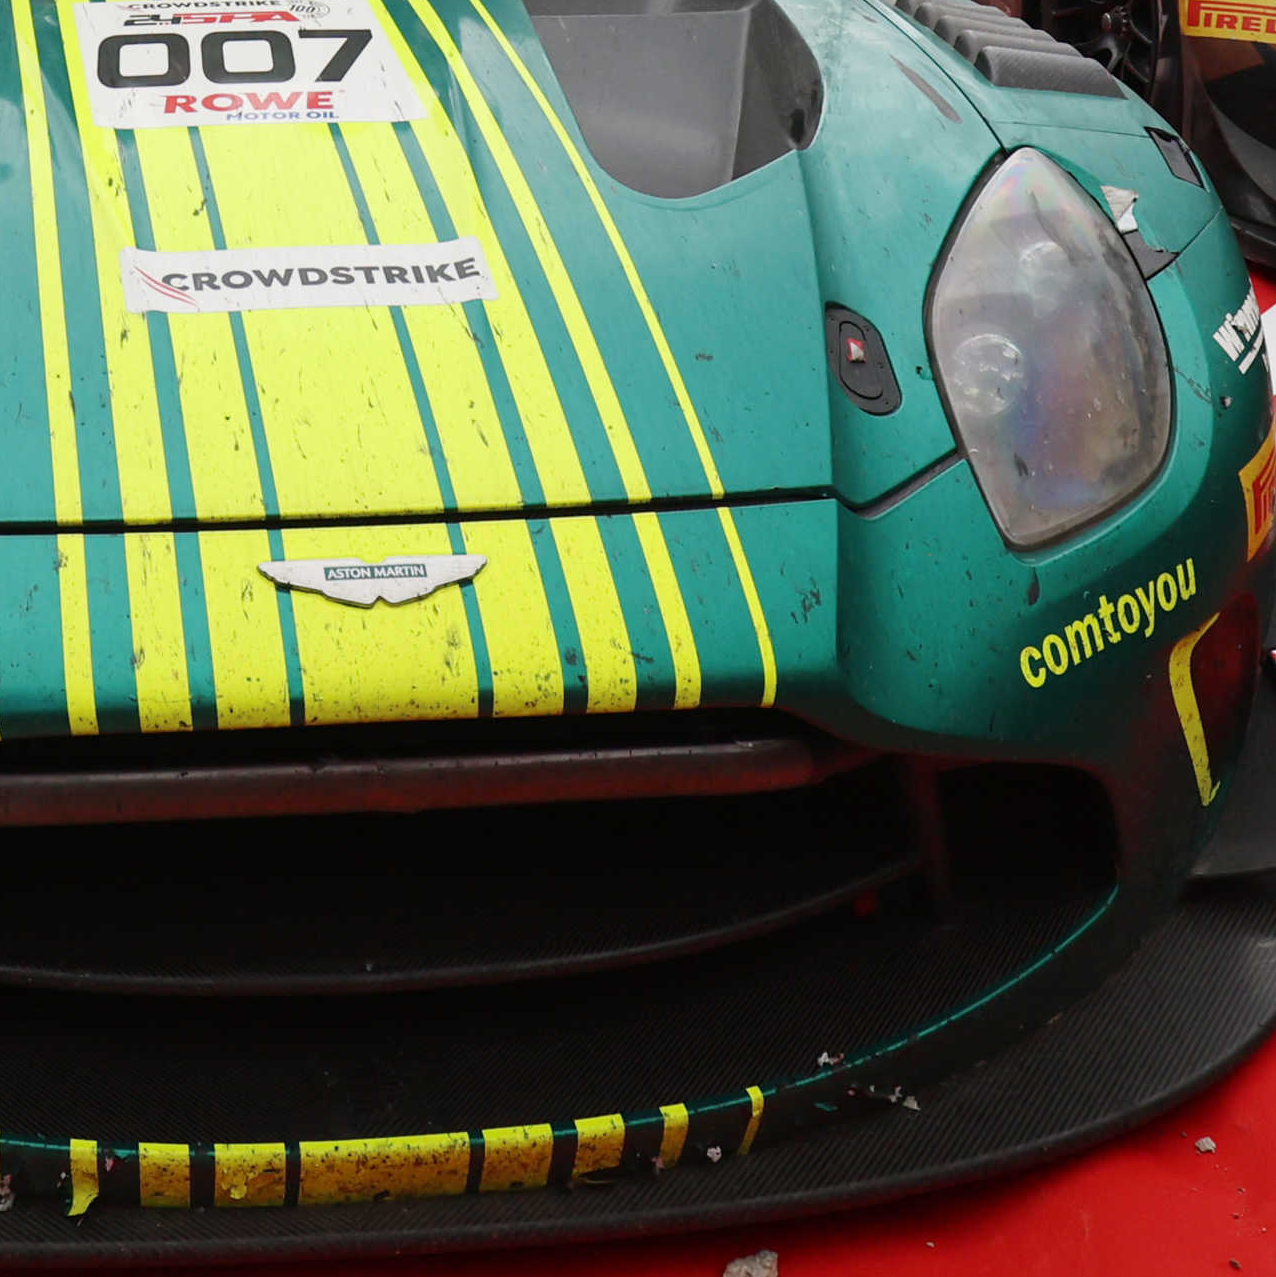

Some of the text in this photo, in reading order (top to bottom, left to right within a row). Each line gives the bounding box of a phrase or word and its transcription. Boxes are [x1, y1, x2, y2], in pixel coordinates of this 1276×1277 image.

[128, 0, 282, 10] CROWDSTRIKE
[97, 29, 373, 88] 007
[163, 91, 335, 114] ROWE
[226, 111, 339, 121] MOTOR OIL
[161, 257, 481, 293] CROWDSTRIKE
[326, 565, 424, 580] ASTON MARTIN
[1020, 557, 1197, 689] comtoyou
